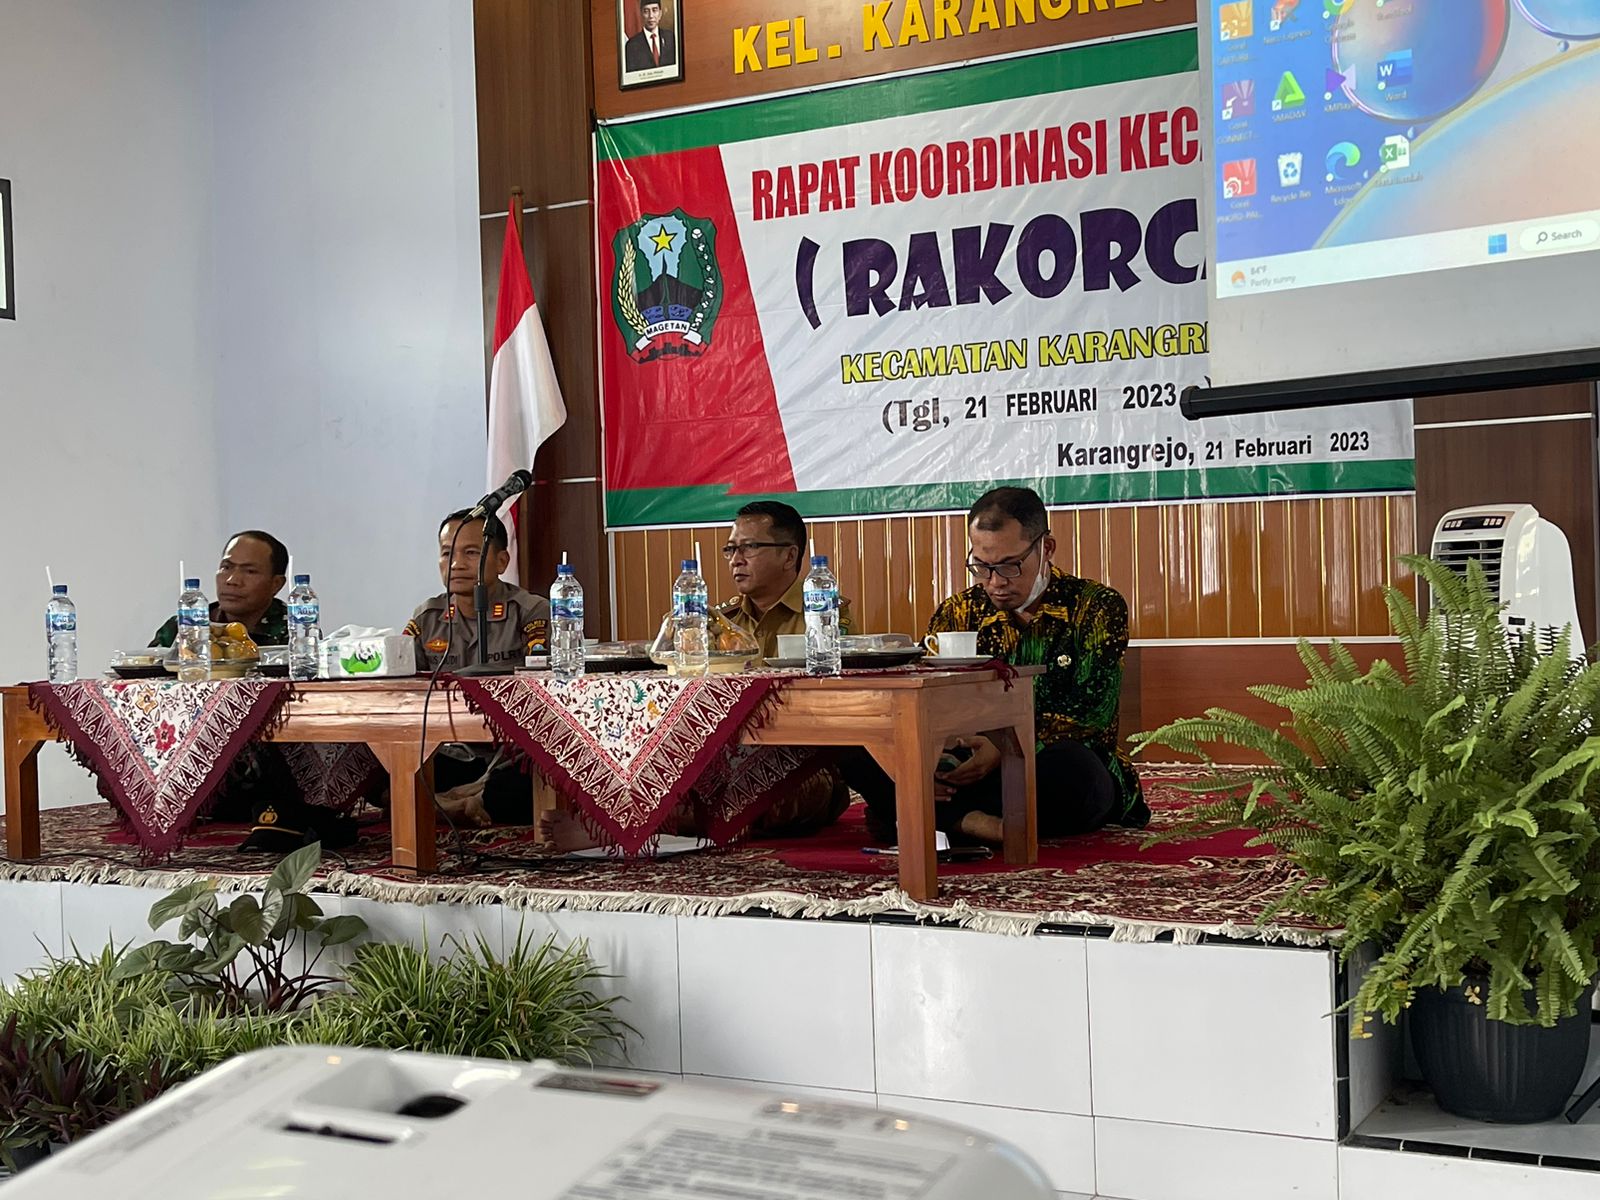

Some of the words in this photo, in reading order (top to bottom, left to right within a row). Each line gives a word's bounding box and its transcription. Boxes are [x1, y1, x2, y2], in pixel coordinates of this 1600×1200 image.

[733, 17, 842, 74] KEL.
[863, 0, 1168, 51] KARAN
[752, 156, 860, 221] RAPAT
[870, 120, 1107, 206] KOORDINASI
[1119, 106, 1203, 172] KEC
[842, 198, 1207, 318] RAKORC
[1551, 229, 1582, 241] Search
[646, 322, 687, 336] MAGETAN
[841, 339, 1028, 384] KECAMATAN
[1038, 320, 1210, 367] KARANGR
[882, 398, 949, 434] (Tgl,
[964, 396, 987, 419] 21
[1006, 388, 1098, 417] FEBRUARI
[1122, 382, 1177, 410] 2023
[1057, 436, 1194, 470] Karangrejo,
[1205, 440, 1223, 460] 21
[1235, 435, 1312, 458] Februari
[1330, 431, 1370, 452] 2023
